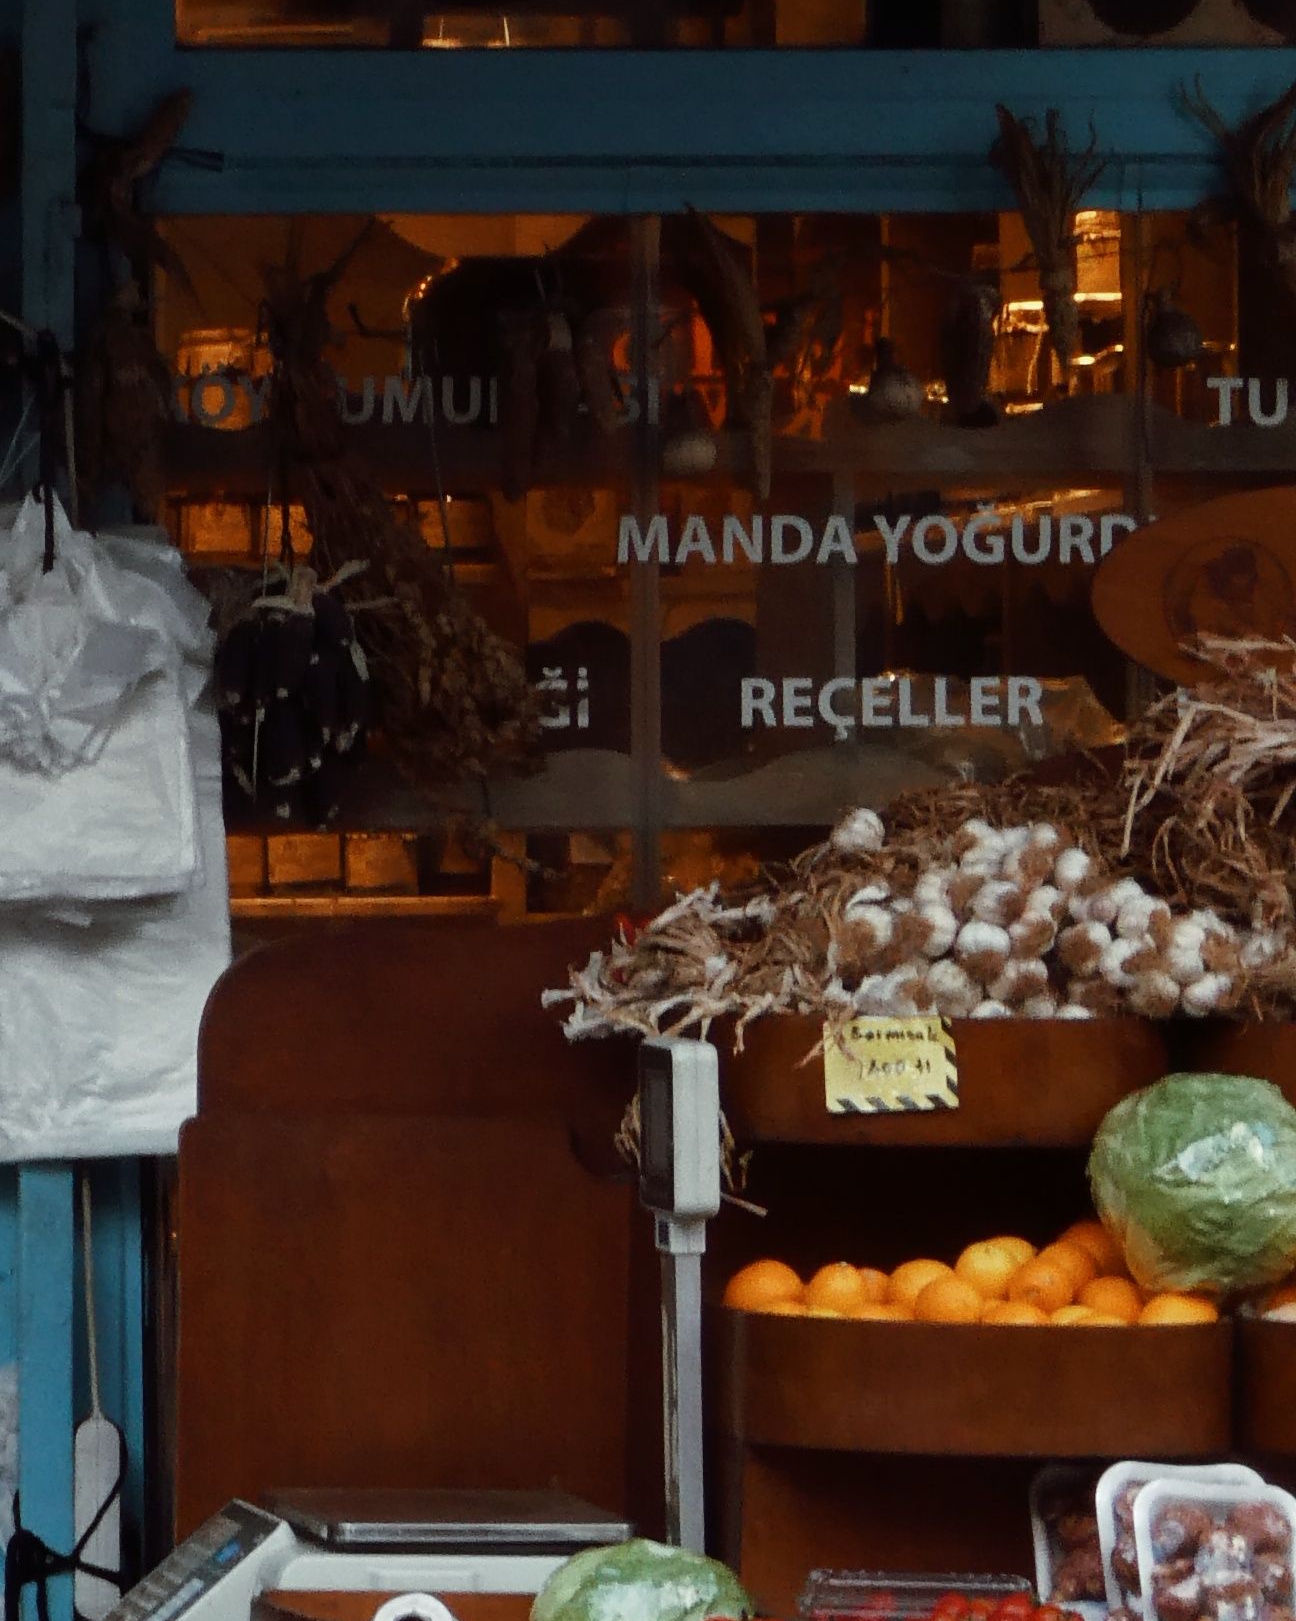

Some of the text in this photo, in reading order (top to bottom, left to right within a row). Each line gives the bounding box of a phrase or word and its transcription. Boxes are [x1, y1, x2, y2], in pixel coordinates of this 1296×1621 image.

[616, 502, 1158, 566] MANDA YOĞURD
[740, 675, 1044, 741] REÇELLER
